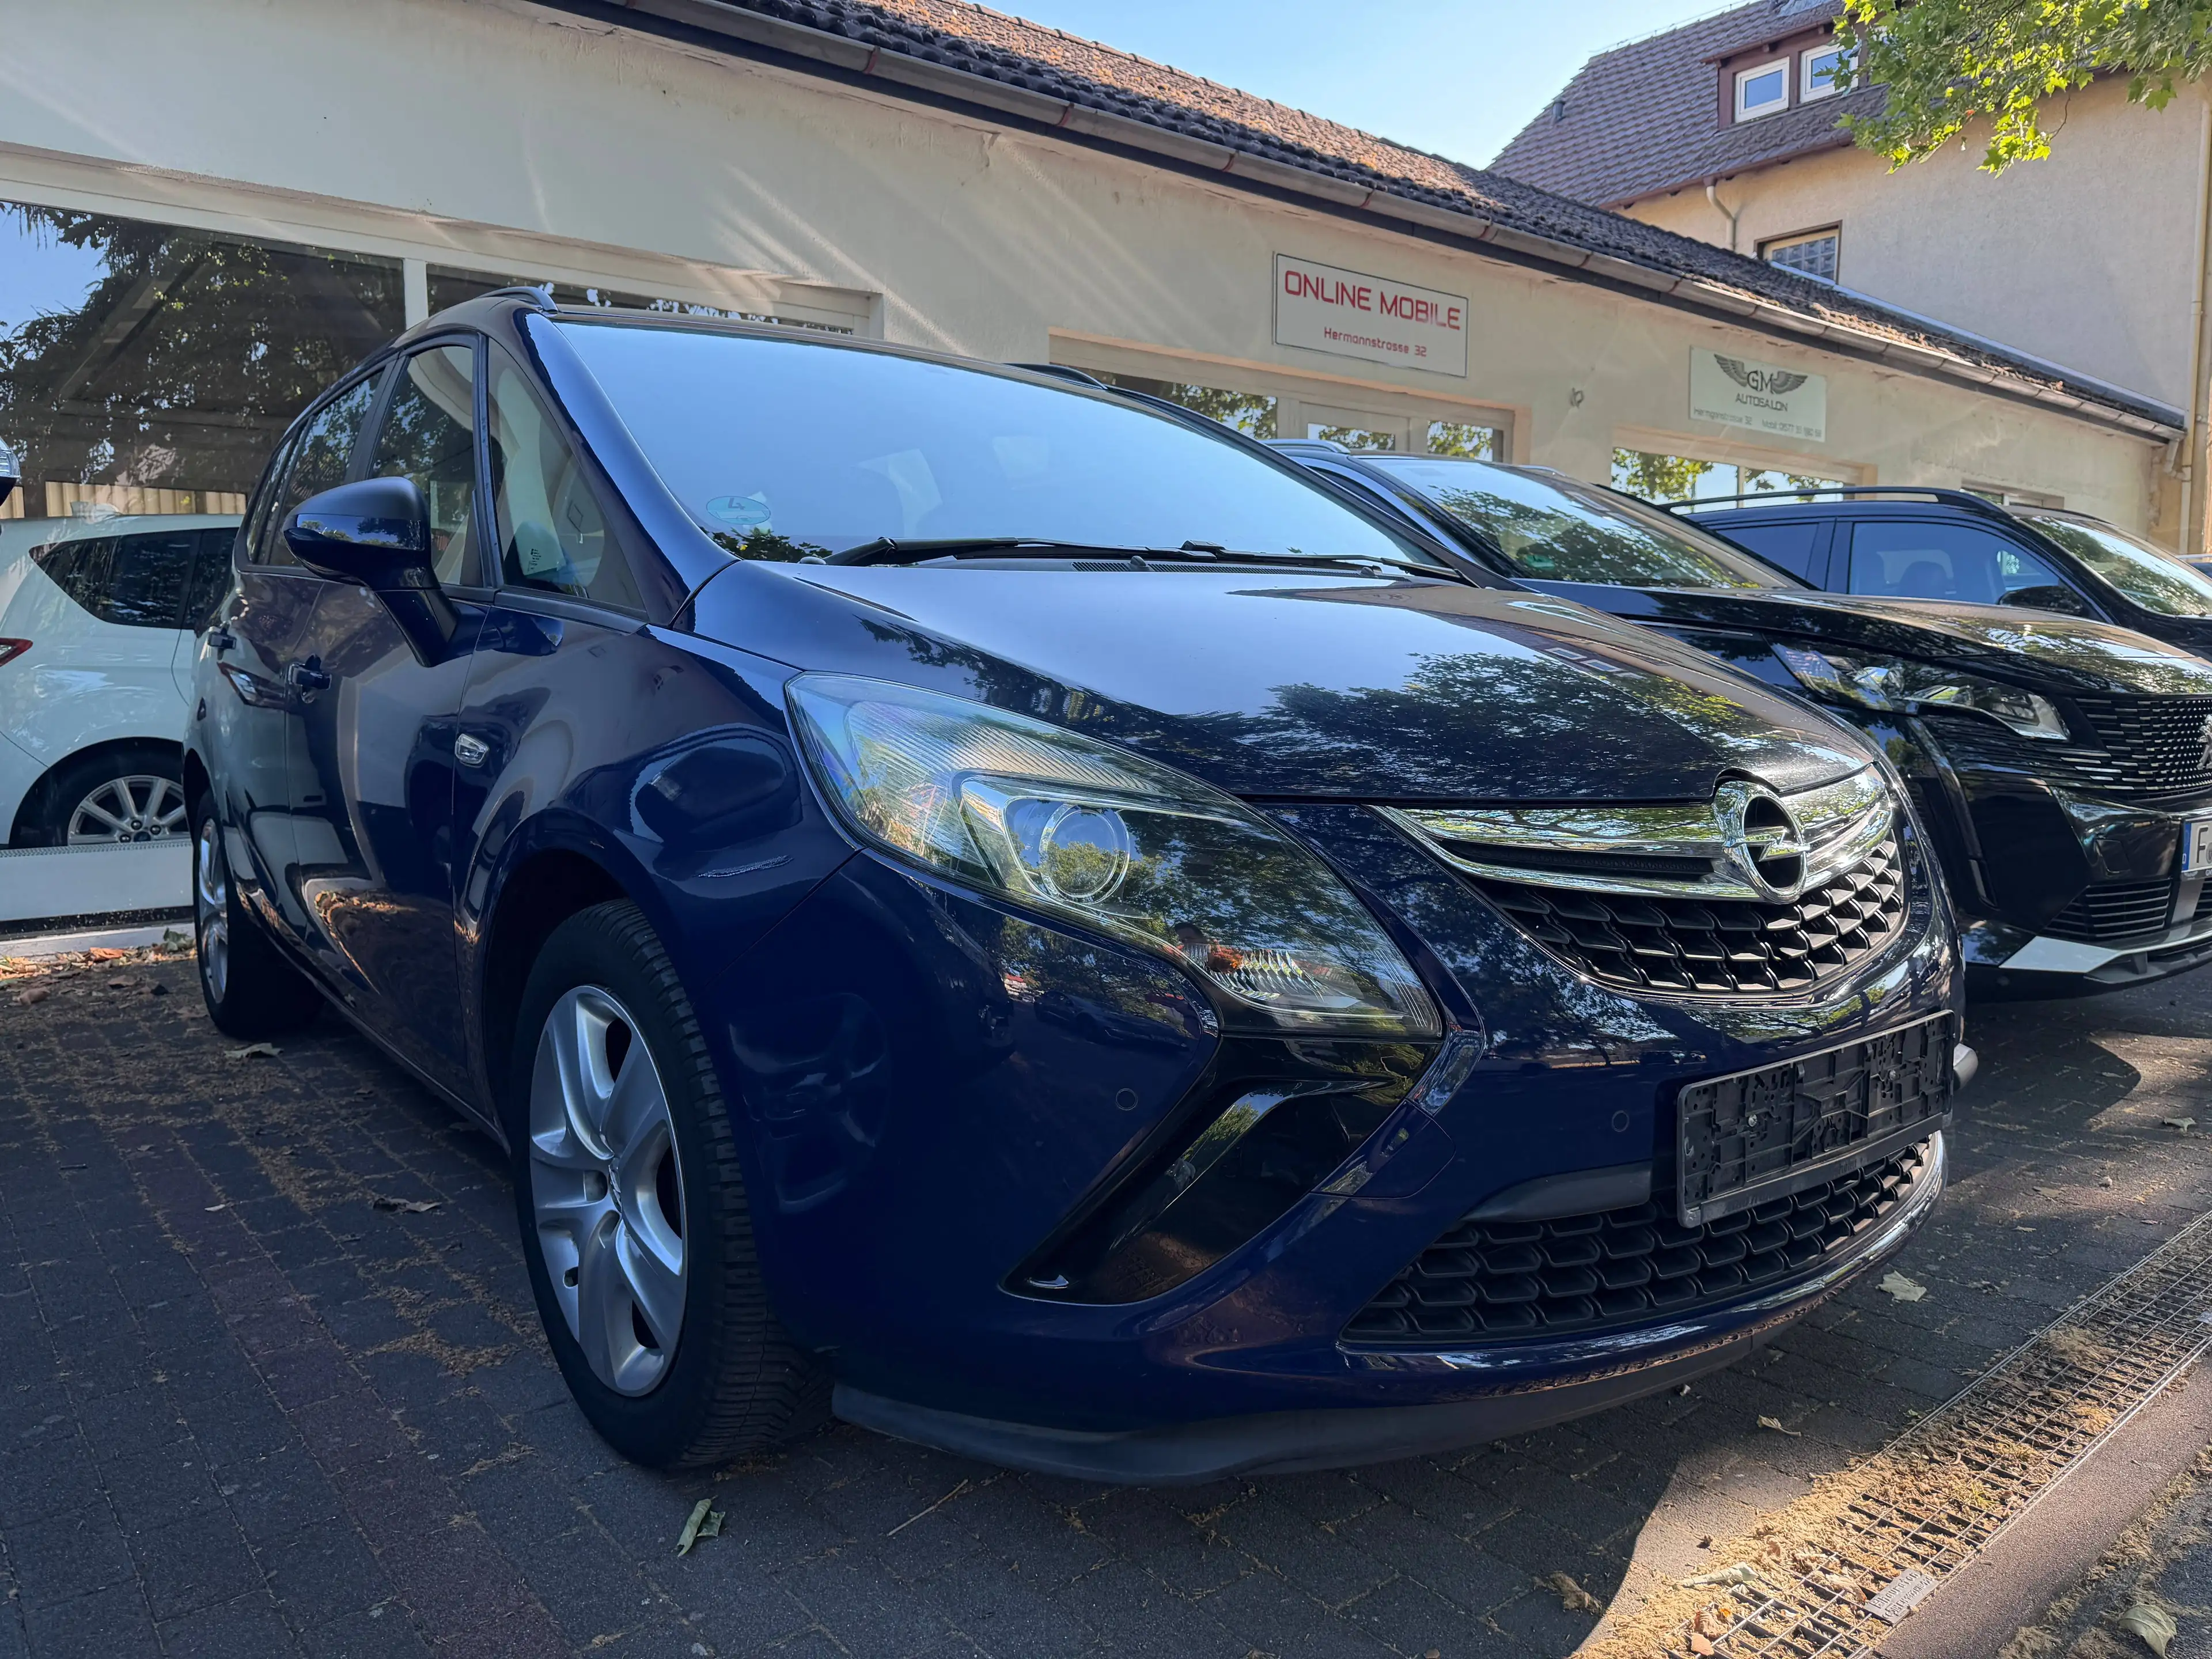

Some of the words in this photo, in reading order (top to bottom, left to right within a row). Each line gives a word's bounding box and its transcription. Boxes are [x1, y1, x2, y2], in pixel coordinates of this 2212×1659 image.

[1285, 270, 1372, 312] ONLINE
[1380, 290, 1461, 331] MOBILE
[1324, 326, 1410, 354] Hermannstrasse
[1414, 345, 1427, 357] 32
[1747, 370, 1775, 395] GM
[1735, 392, 1789, 412] AUTOSALON
[728, 498, 745, 510] 4
[2196, 826, 2209, 863] F
[2182, 853, 2187, 864] D
